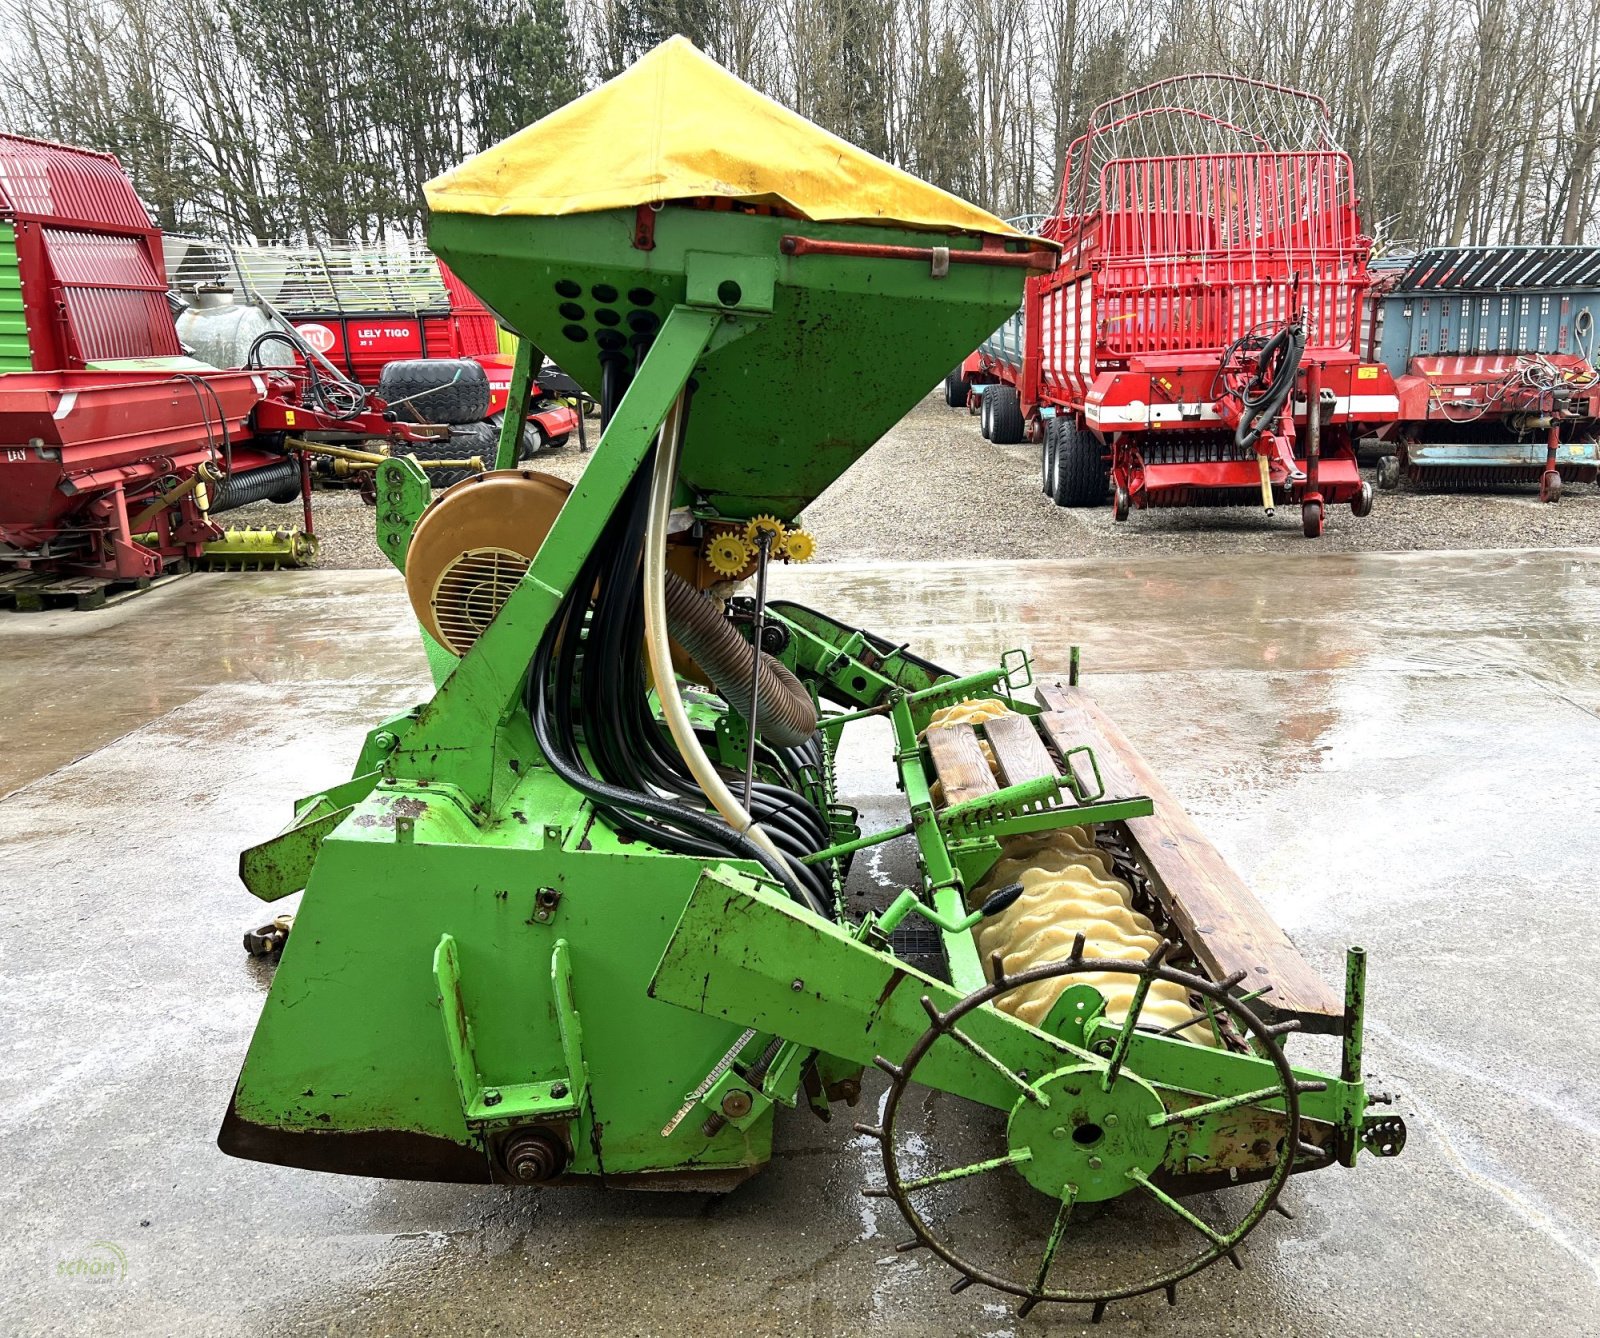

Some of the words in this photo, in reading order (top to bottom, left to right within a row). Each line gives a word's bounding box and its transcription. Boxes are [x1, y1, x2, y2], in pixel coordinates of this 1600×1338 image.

[358, 329, 381, 338] LELY
[384, 328, 410, 338] TIGO
[7, 448, 26, 462] LELY
